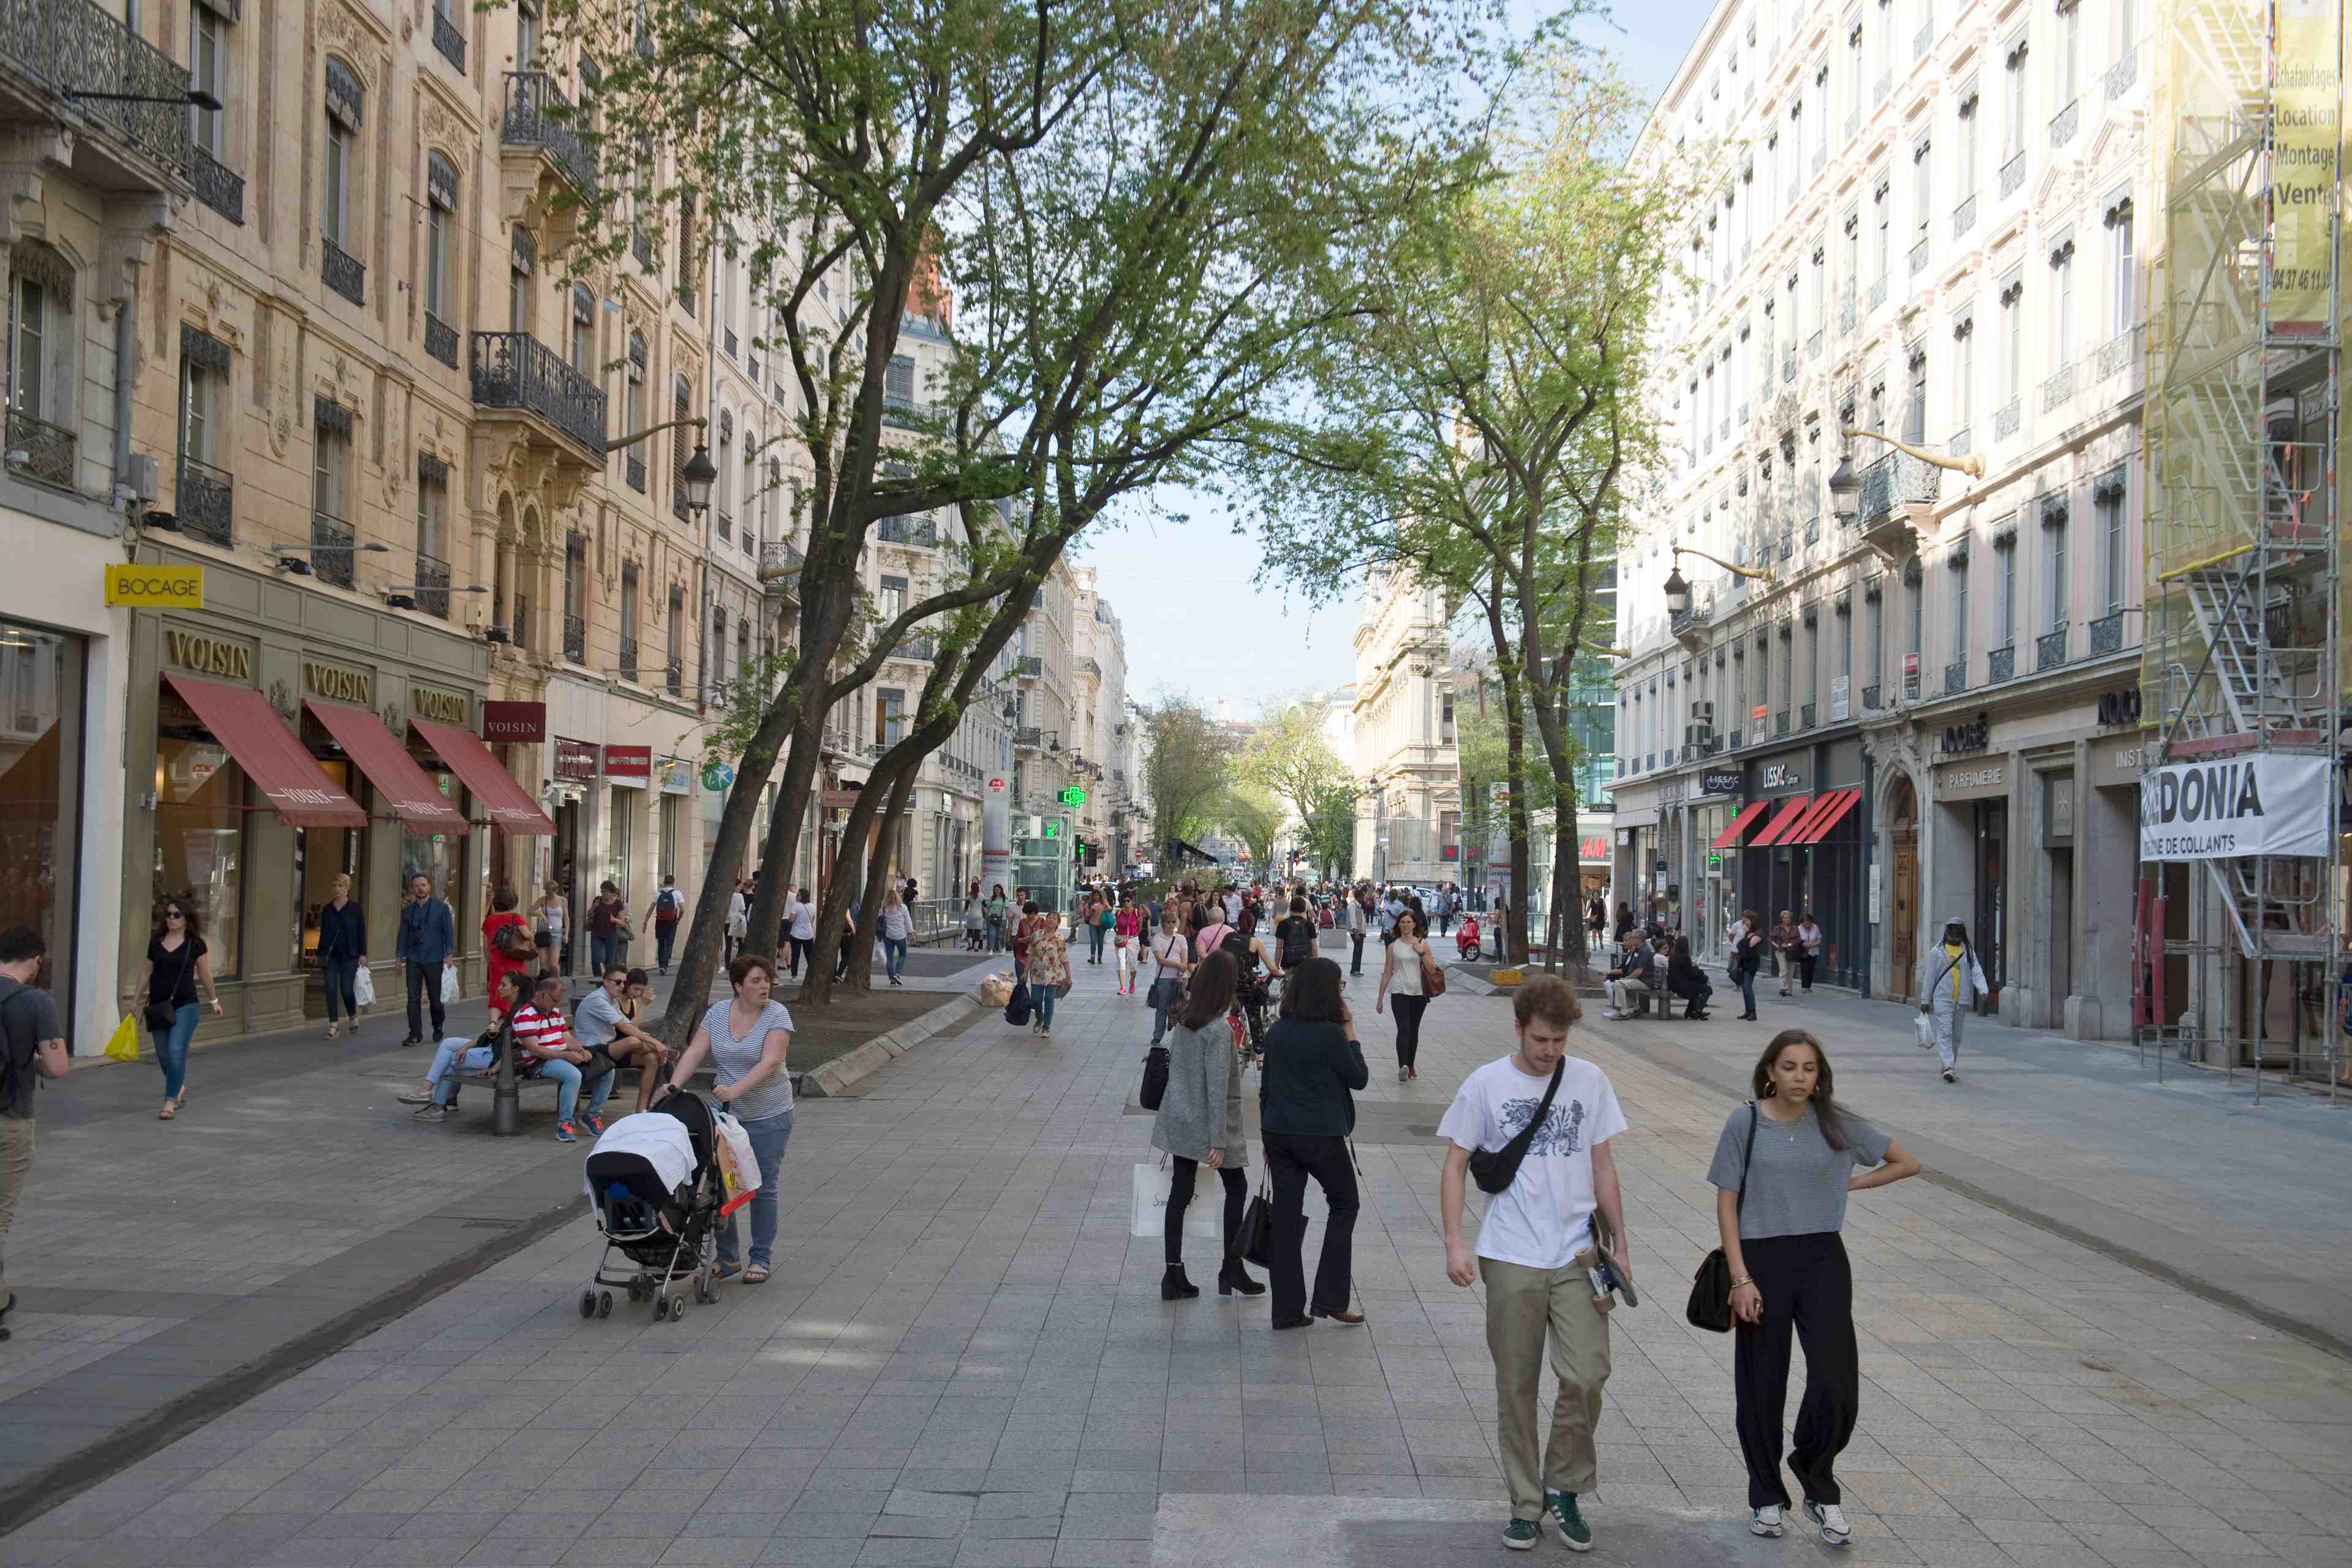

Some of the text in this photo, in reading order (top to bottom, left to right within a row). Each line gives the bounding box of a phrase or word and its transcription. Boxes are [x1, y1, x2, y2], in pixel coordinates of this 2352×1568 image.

[2276, 104, 2335, 126] Location
[2276, 143, 2334, 171] Montage
[2273, 268, 2283, 290] 04
[2285, 269, 2297, 291] 37
[2298, 268, 2309, 291] 46
[118, 578, 198, 596] BOCAGE
[168, 631, 252, 679] VOISIN
[304, 663, 372, 704] VOISIN
[414, 688, 467, 723] VOISIN
[488, 722, 537, 733] VOISIN
[1764, 764, 1785, 788] LISSAC
[1950, 768, 2002, 788] PARFUMERIE
[279, 788, 333, 804] VOISIN
[2166, 837, 2178, 854] DE
[2180, 834, 2235, 854] COLLANTS
